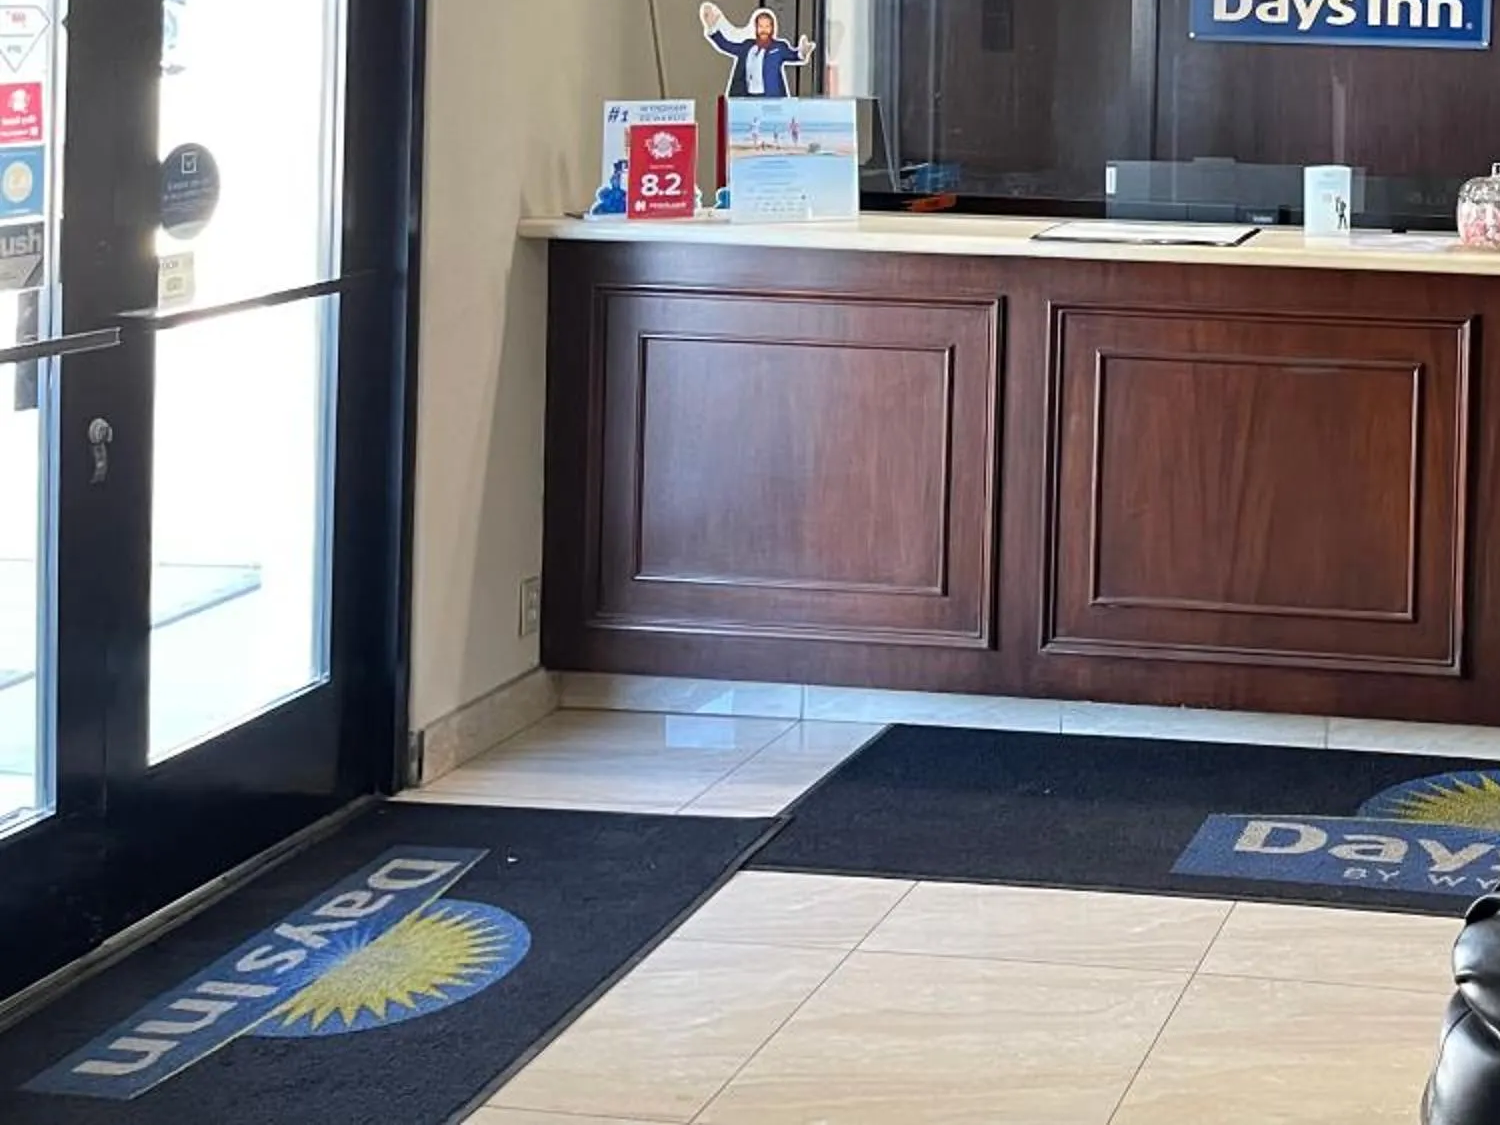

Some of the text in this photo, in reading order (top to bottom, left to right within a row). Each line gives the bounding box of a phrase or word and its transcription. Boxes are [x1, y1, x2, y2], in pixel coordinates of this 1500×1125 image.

[607, 106, 629, 123] #1
[641, 172, 682, 196] 8.2
[71, 857, 461, 1076] Days Inn
